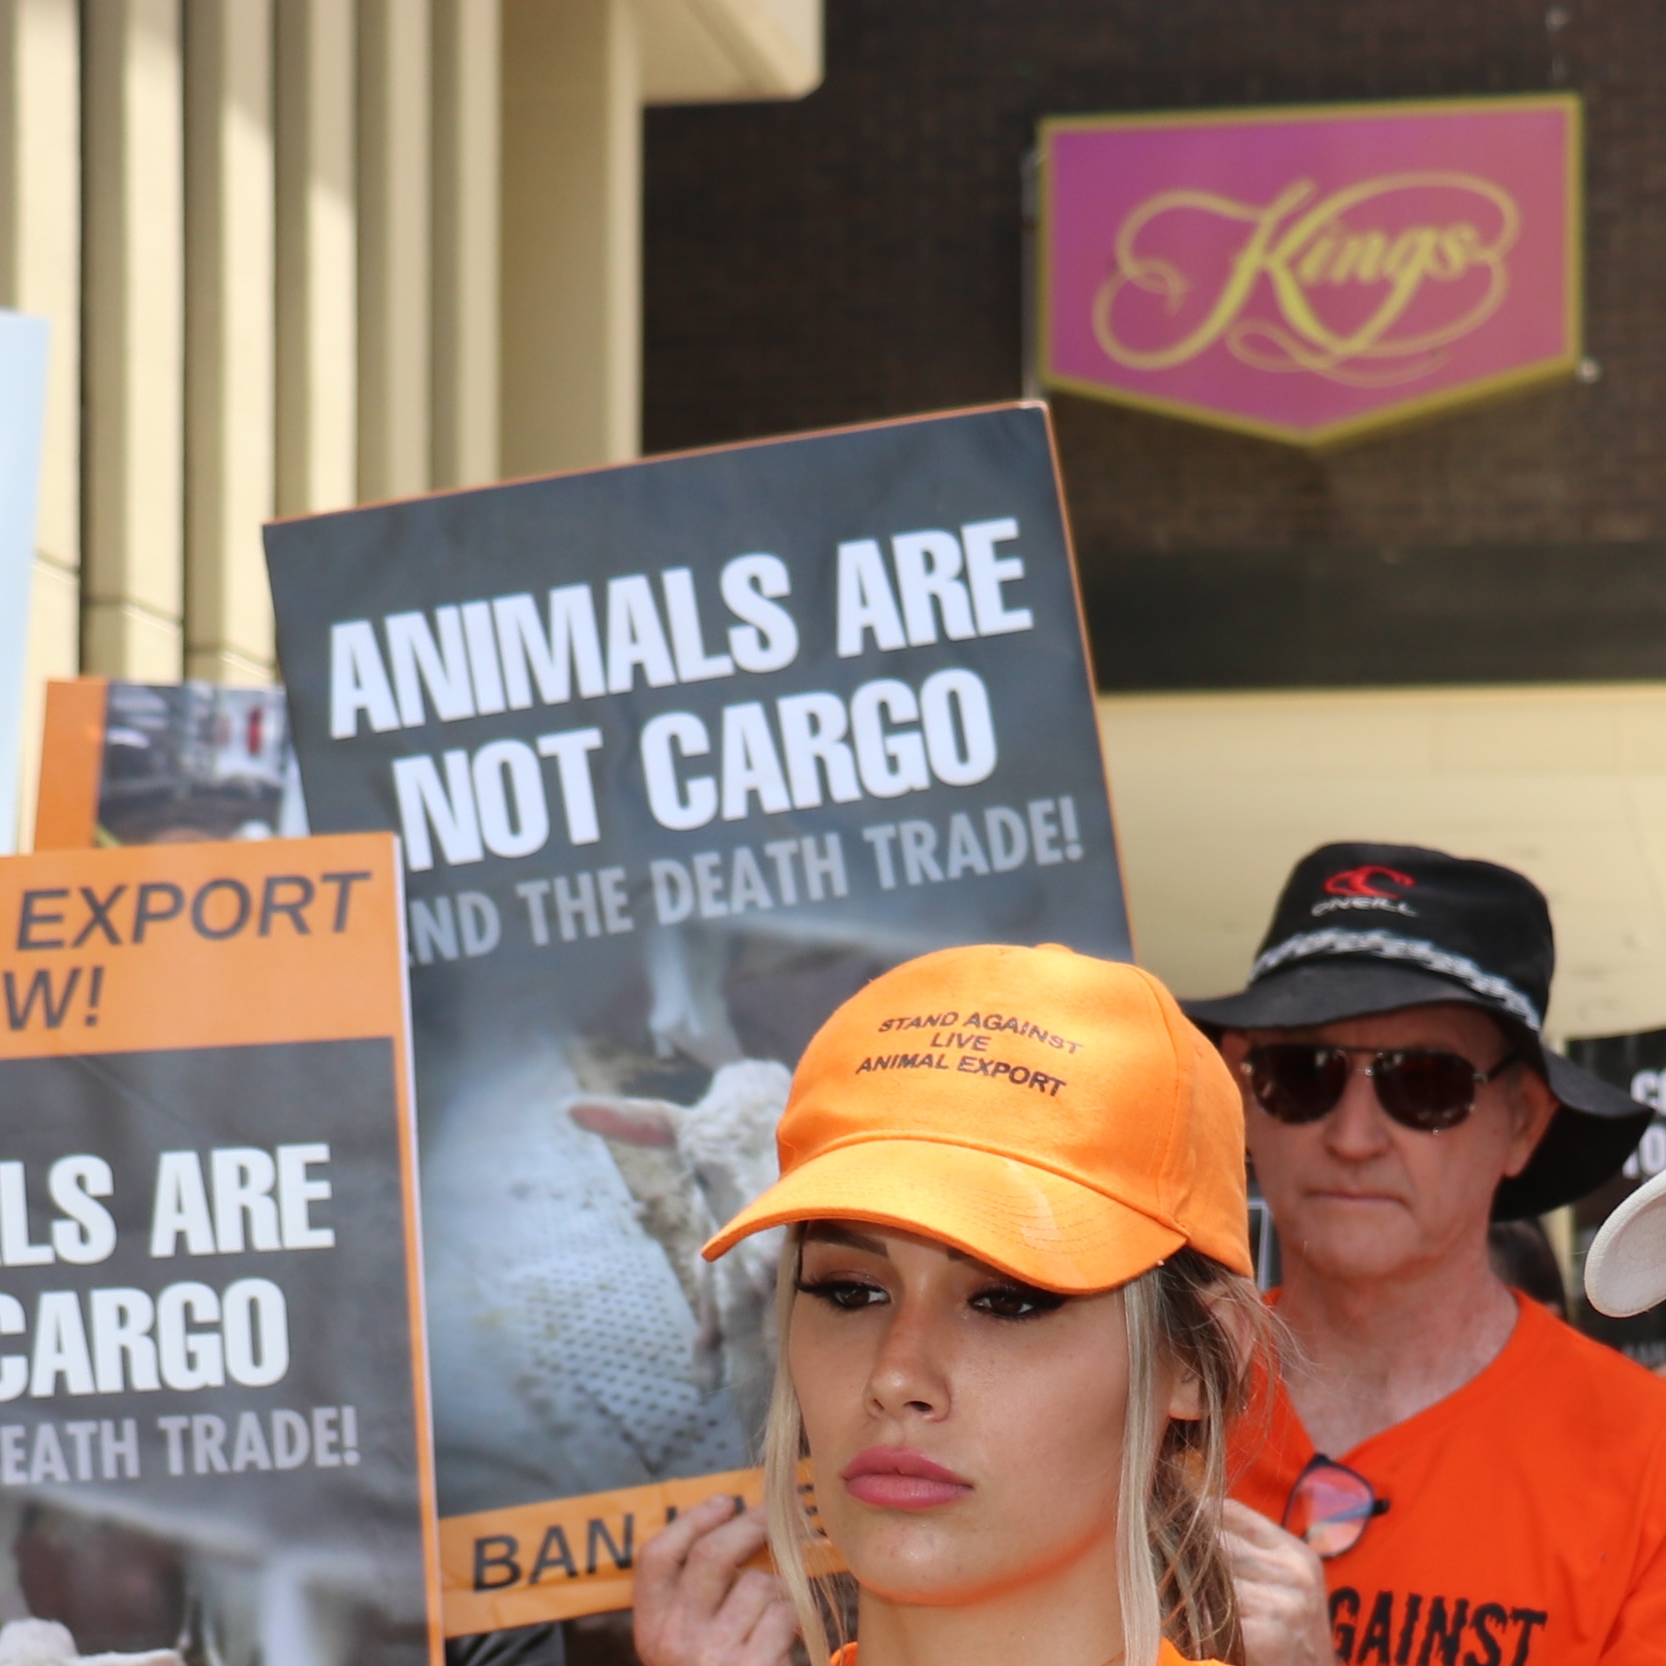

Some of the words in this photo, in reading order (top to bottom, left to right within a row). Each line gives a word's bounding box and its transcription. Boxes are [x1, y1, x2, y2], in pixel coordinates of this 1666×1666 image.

[331, 552, 800, 742] ANIMALS
[835, 516, 1034, 660] ARE
[392, 728, 603, 873] NOT
[641, 667, 998, 832] CARGO
[15, 870, 372, 951] EXPORT
[408, 890, 501, 968] ND
[517, 866, 634, 946] THE
[650, 832, 850, 927] DEATH
[873, 795, 1084, 890] TRADE!
[878, 1011, 959, 1033] STAND
[962, 1011, 1083, 1055] AGAINST
[930, 1031, 992, 1052] LIVE
[855, 1053, 949, 1075] ANIMAL
[956, 1055, 1067, 1097] EXPORT
[150, 1143, 335, 1259] ARE
[158, 1405, 360, 1478] TRADE!
[474, 1513, 633, 1592] BAN
